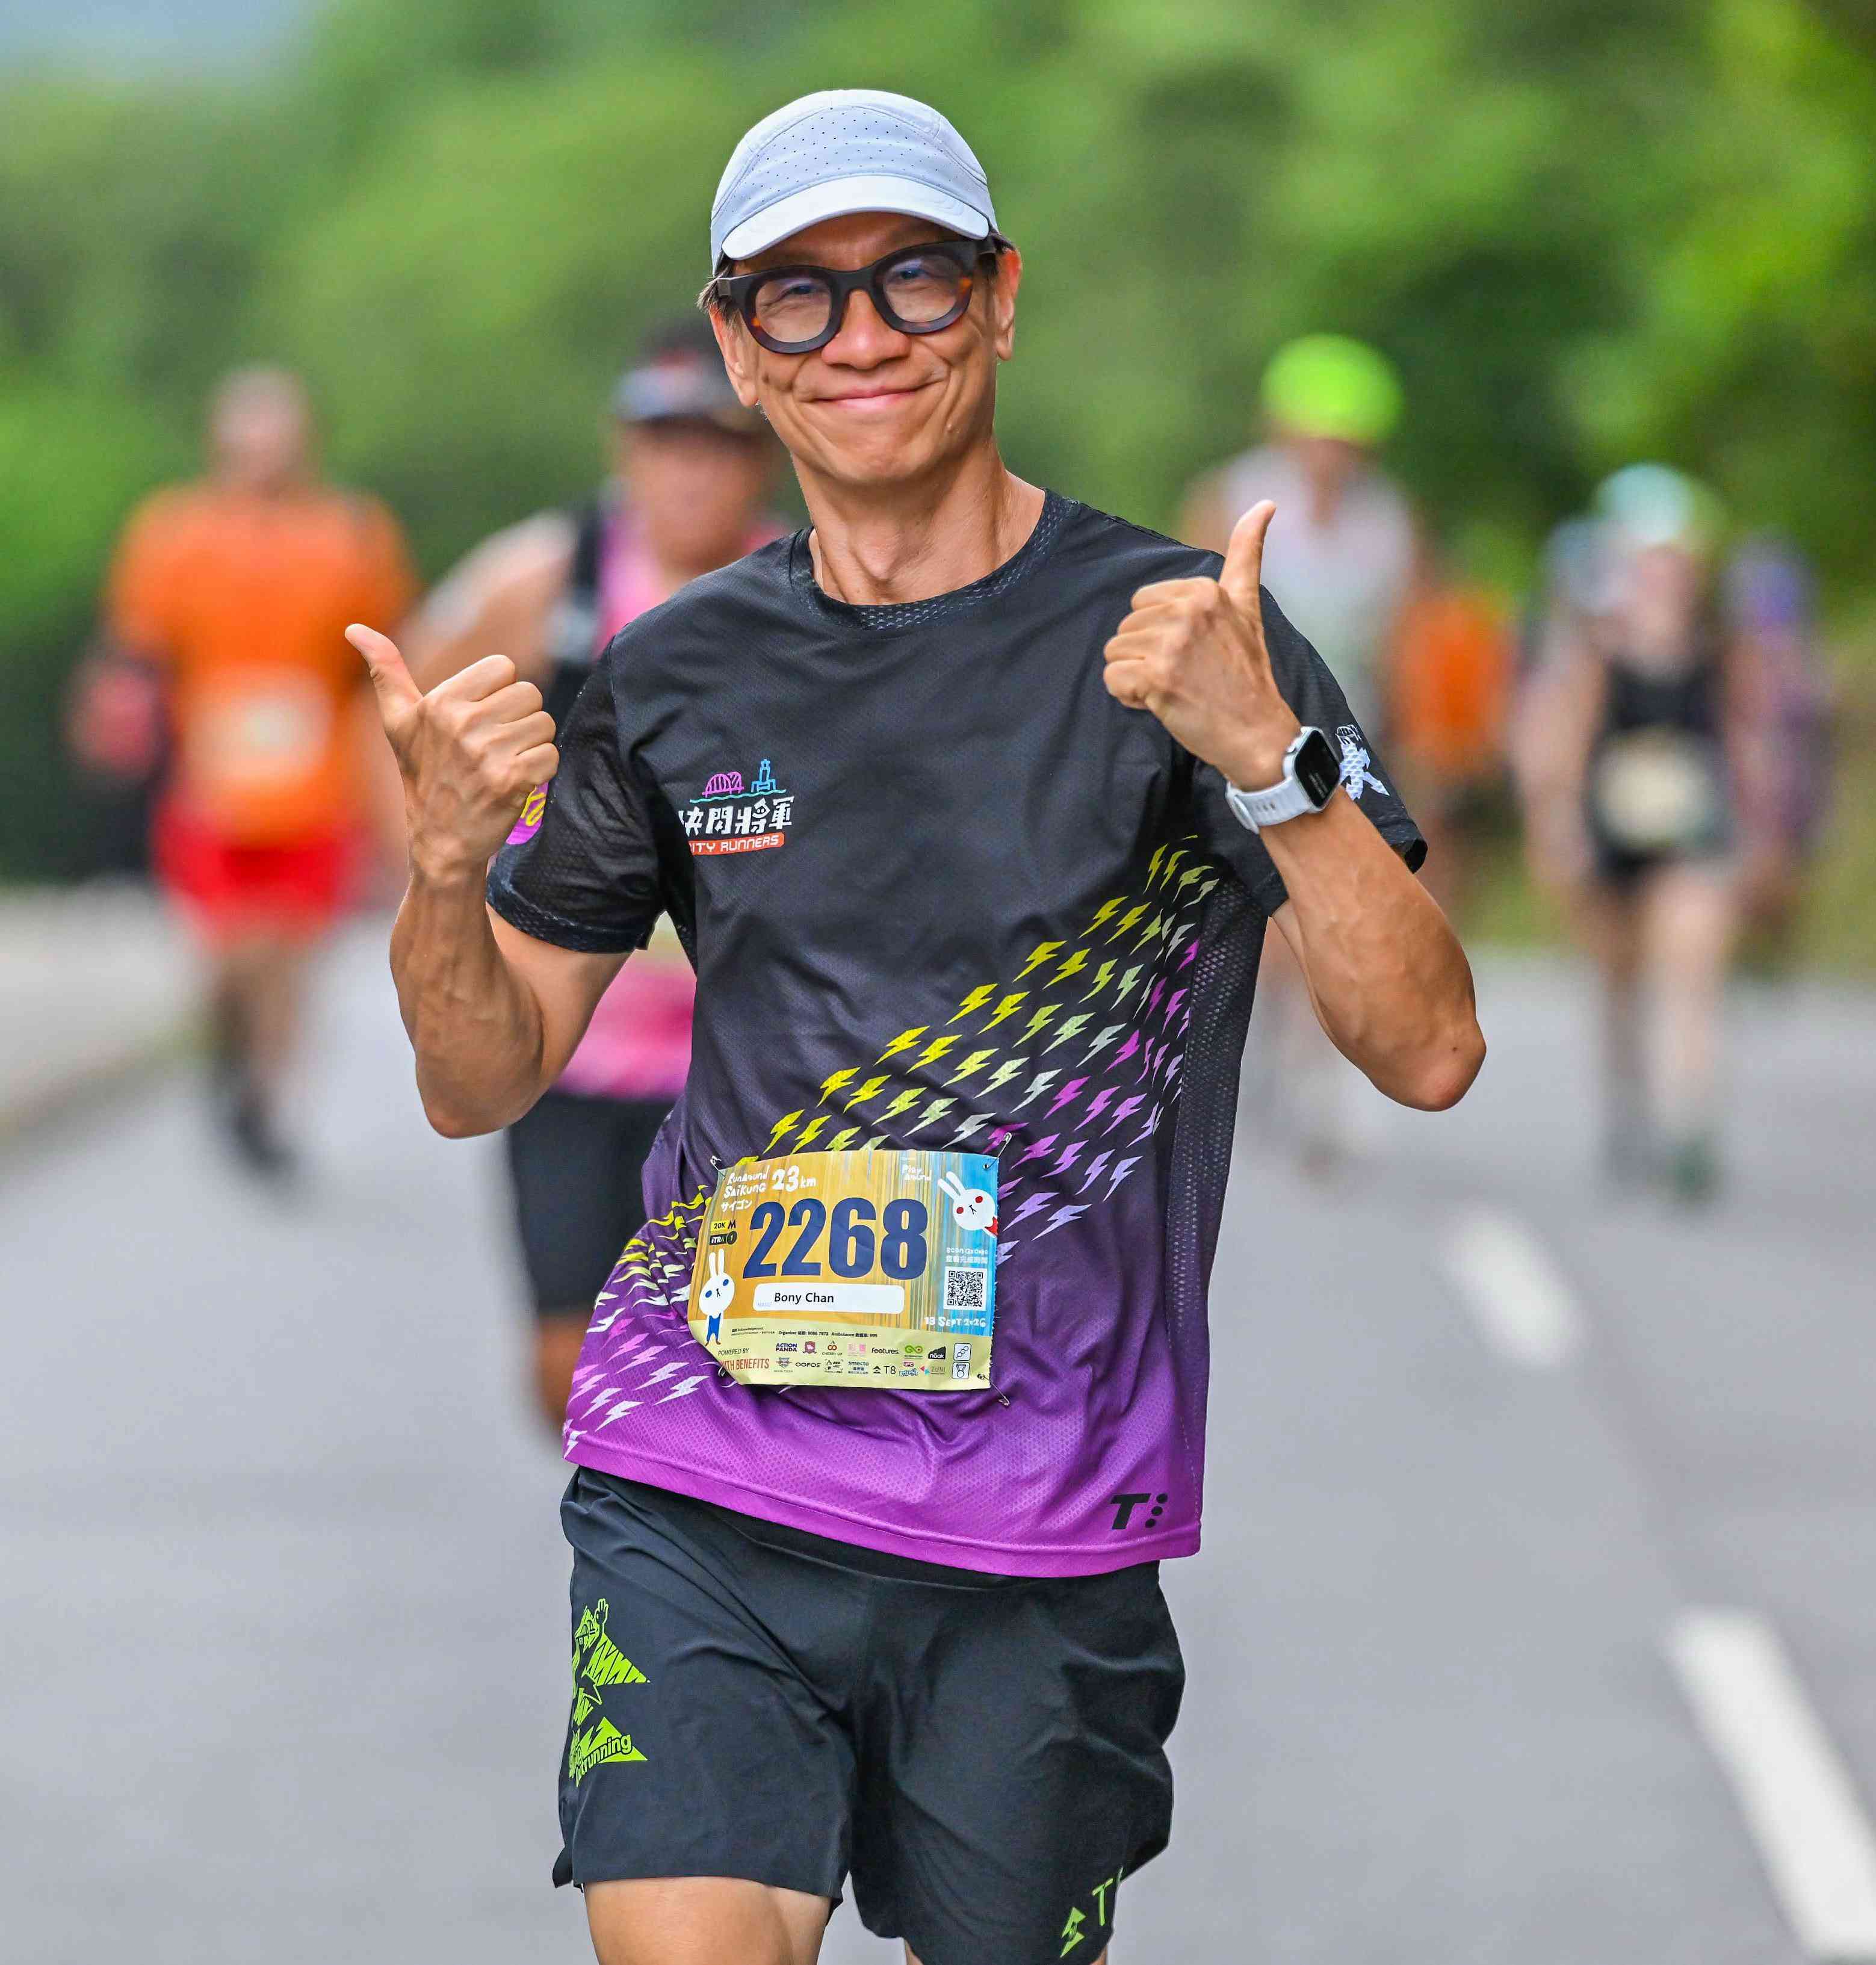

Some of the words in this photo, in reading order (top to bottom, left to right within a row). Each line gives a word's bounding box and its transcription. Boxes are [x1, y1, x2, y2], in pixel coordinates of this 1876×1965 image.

[690, 843, 716, 853] ITY
[720, 835, 779, 852] RUNNERS
[742, 1197, 928, 1280] 2268
[774, 1292, 802, 1305] Bony
[805, 1292, 834, 1302] Chan
[718, 1348, 741, 1357] POWERED
[736, 1358, 770, 1370] BENEFITS
[884, 1366, 896, 1375] T8
